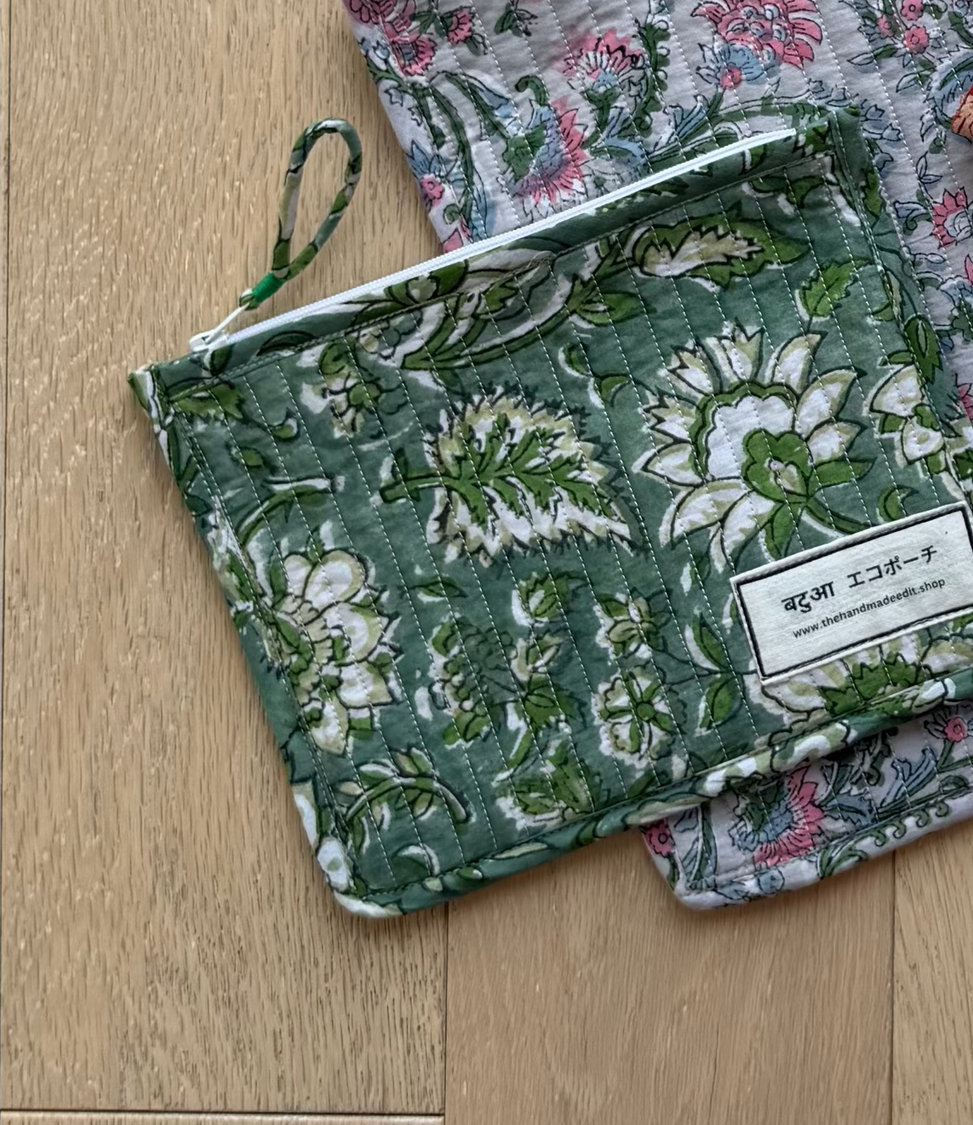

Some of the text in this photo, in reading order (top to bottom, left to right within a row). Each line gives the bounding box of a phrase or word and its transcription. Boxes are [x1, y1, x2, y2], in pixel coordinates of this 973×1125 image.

[781, 545, 938, 613] बटुआ エコポーチ
[793, 578, 946, 638] www.thehandmadeedit.shop
